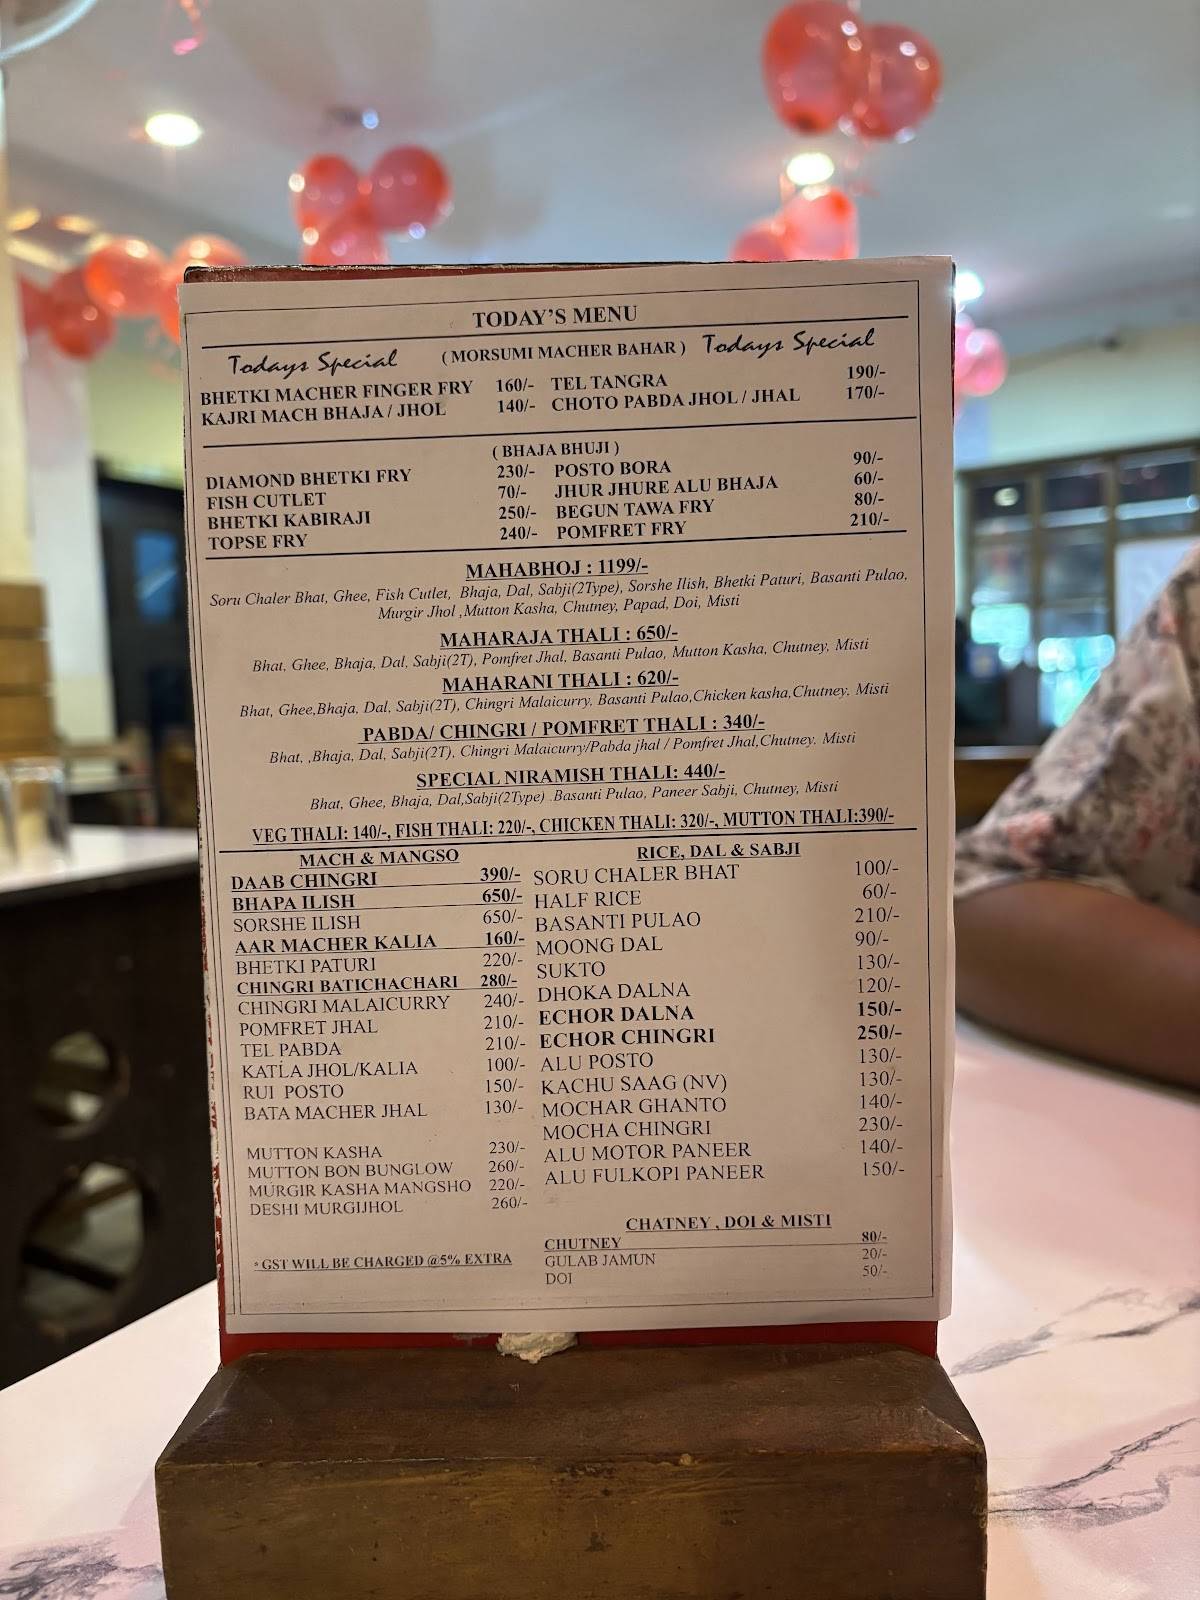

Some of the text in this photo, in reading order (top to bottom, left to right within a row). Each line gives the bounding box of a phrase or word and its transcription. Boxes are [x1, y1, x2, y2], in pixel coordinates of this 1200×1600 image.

[573, 305, 637, 324] MENU
[702, 328, 875, 359] Todays Special
[228, 348, 397, 380] Todays Special
[551, 365, 886, 391] TEL TANGRA 190/-
[200, 377, 534, 406] BHETKI MACHER FINGER FRY 160/-
[205, 464, 535, 490] DIAMOND BHETKI FRY 230/-
[554, 451, 883, 480] POSTO BORA 90/-
[206, 484, 527, 510] FISH CUTLET 70/-
[555, 470, 884, 502] JHUR JHURE ALU BHAJA 60/-
[207, 505, 537, 530] BHETKI KABIRAJI 250/-
[555, 491, 884, 523] BEGUN TAWA FRY 80/-
[208, 524, 538, 550] TOPSE FRY 240/-
[557, 512, 889, 540] POMFRET FRY 210/-
[465, 562, 581, 580] MAHABHOJ
[599, 557, 649, 575] 1199/-
[209, 593, 242, 608] Soru
[246, 592, 291, 605] Chaler
[376, 588, 405, 601] Fish
[628, 578, 672, 592] Sorshe
[713, 574, 755, 593] Bhetki
[810, 570, 860, 583] Basanti
[439, 629, 552, 649] MAHARAJA
[557, 626, 620, 643] THALI
[636, 624, 678, 641] 650/-
[482, 651, 532, 668] Pomfret
[571, 647, 621, 664] Basanti
[672, 645, 718, 658] Mutton
[835, 638, 868, 651] Misti
[252, 828, 287, 843] VEG
[291, 826, 348, 842] THALI:
[396, 823, 432, 838] FISH
[436, 820, 493, 836] THALI:
[537, 816, 615, 832] CHICKEN
[619, 815, 676, 830] THALI:
[723, 810, 796, 829] MUTTON
[800, 807, 894, 824] THALI:390/-
[299, 848, 460, 868] MACH & MANGSO
[690, 844, 726, 858] DAL
[731, 843, 745, 858] &
[749, 841, 801, 857] SABJI
[231, 866, 520, 891] DAAB CHINGRI 390/-
[534, 859, 899, 889] SORU CHALER BHAT 100/-
[232, 888, 523, 912] BHAPA ILISH 650/-
[534, 883, 896, 909] HALF RICE 60/-
[236, 974, 518, 994] CHINGRI BATICHACHARI 280/-
[239, 1014, 524, 1037] POMFRET JHAL 210/-
[538, 1000, 901, 1026] ECHOR DALNA 150/-
[539, 1024, 902, 1052] ECHOR CHINGRI 250/-
[244, 1097, 524, 1120] BATA MACHER JHAL 130/-
[542, 1093, 902, 1118] MOCHAR GHANTO 140/-
[248, 1159, 525, 1181] MUTTON BON BUNGLOW 260/-
[545, 1161, 904, 1185] ALU FULKOPI PANEER 150/-
[544, 1230, 888, 1251] CHUTNEY 80/-
[291, 1257, 329, 1271] WILL
[332, 1256, 351, 1269] BE
[354, 1255, 424, 1269] CHARGED
[427, 1254, 461, 1268] @5%
[465, 1252, 512, 1266] EXTRA
[545, 1248, 887, 1268] GULAB JAMUN 20/-
[545, 1264, 886, 1285] DOI 50/-
